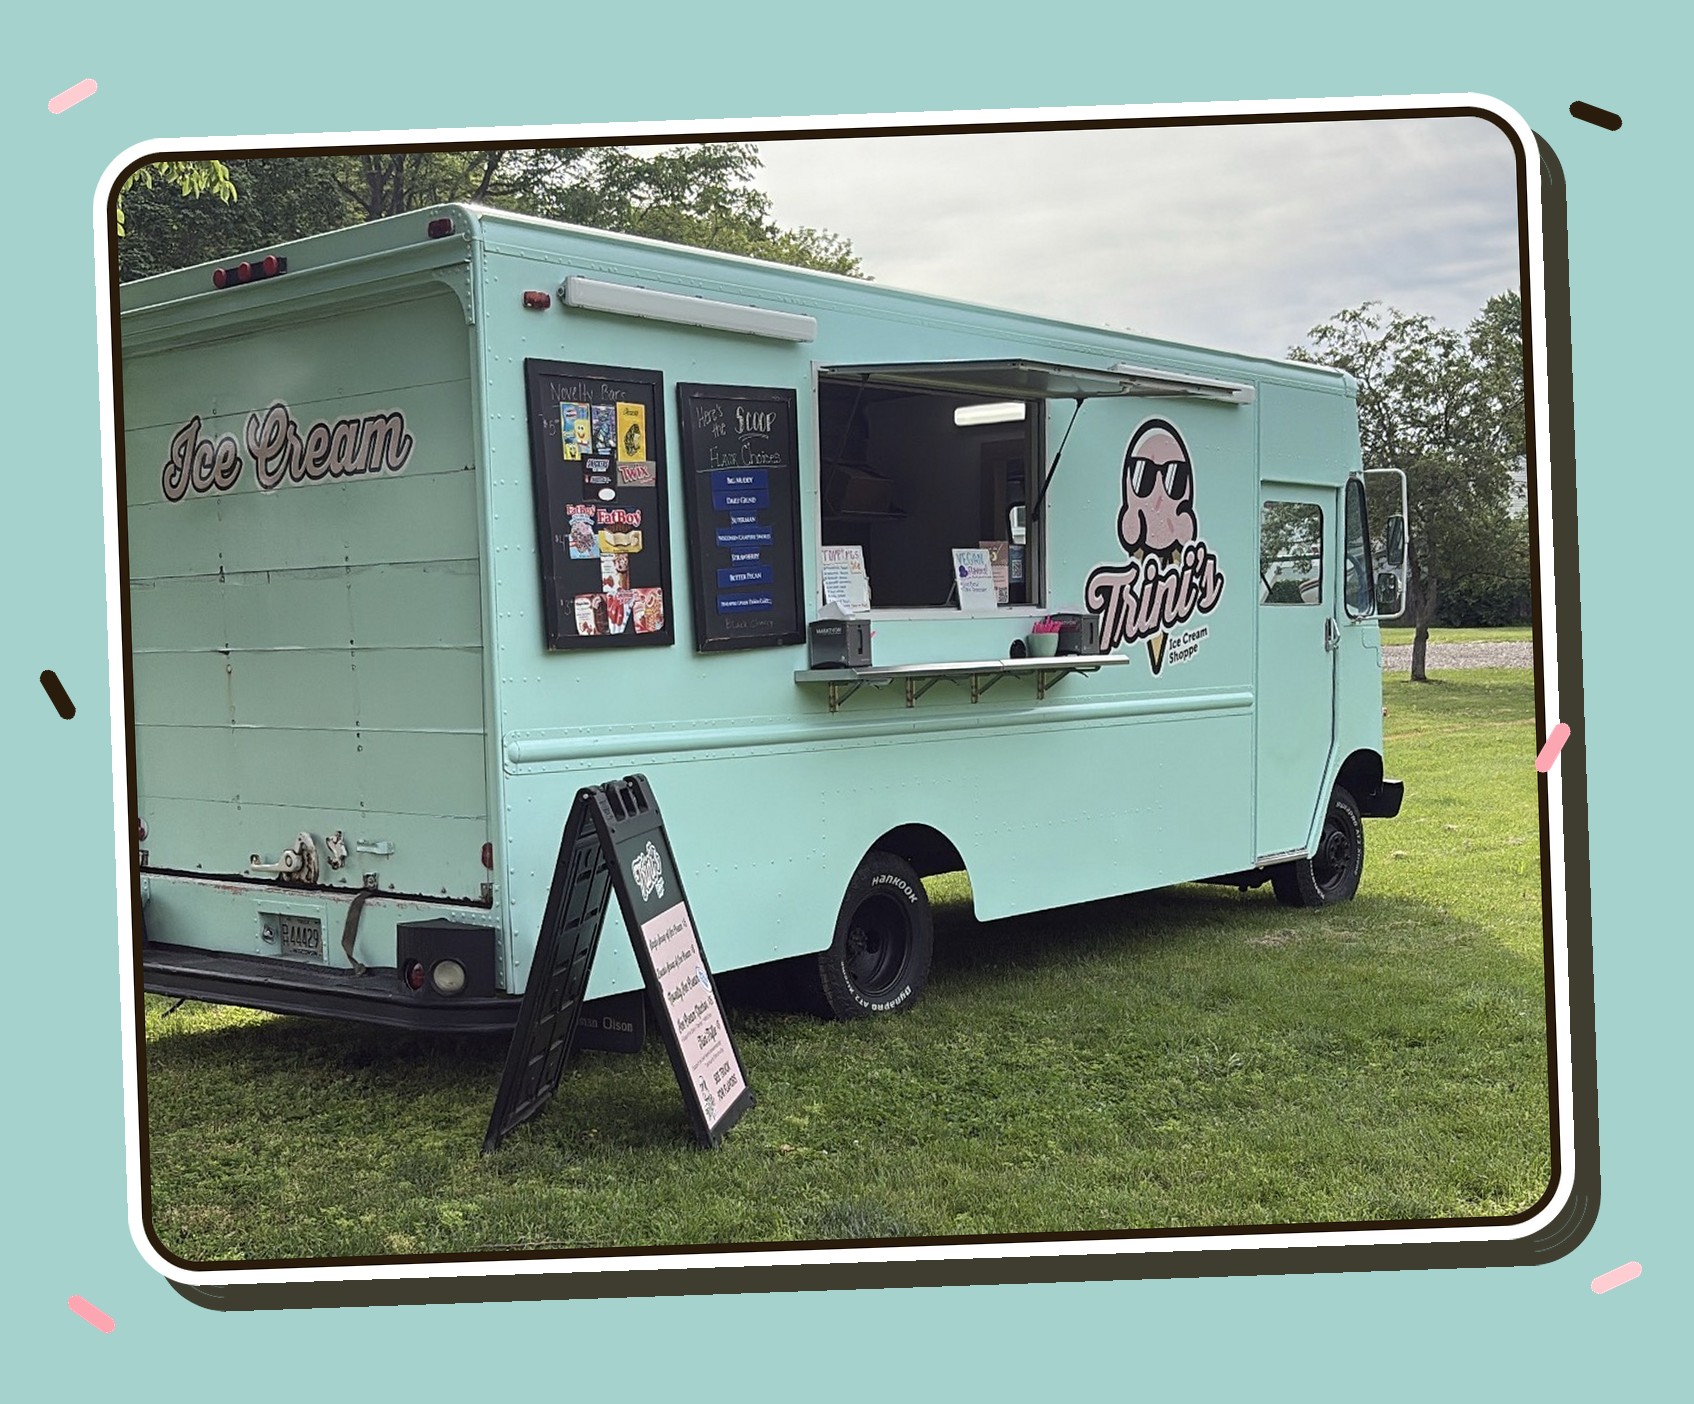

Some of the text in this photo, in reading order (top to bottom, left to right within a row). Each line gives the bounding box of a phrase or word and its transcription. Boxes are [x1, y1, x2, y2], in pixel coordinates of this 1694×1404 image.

[550, 382, 626, 401] Novelty Bars
[695, 404, 723, 428] Here's
[735, 406, 777, 434] SCOOP
[711, 422, 727, 438] the
[162, 402, 413, 502] Ice Cream
[741, 442, 782, 466] Choices
[597, 509, 642, 527] FatBoy
[1085, 542, 1225, 655] Trini's
[1169, 627, 1208, 650] Ice Cream
[1169, 643, 1199, 664] Shoppe
[290, 926, 319, 948] 44429
[602, 1016, 634, 1033] Olson
